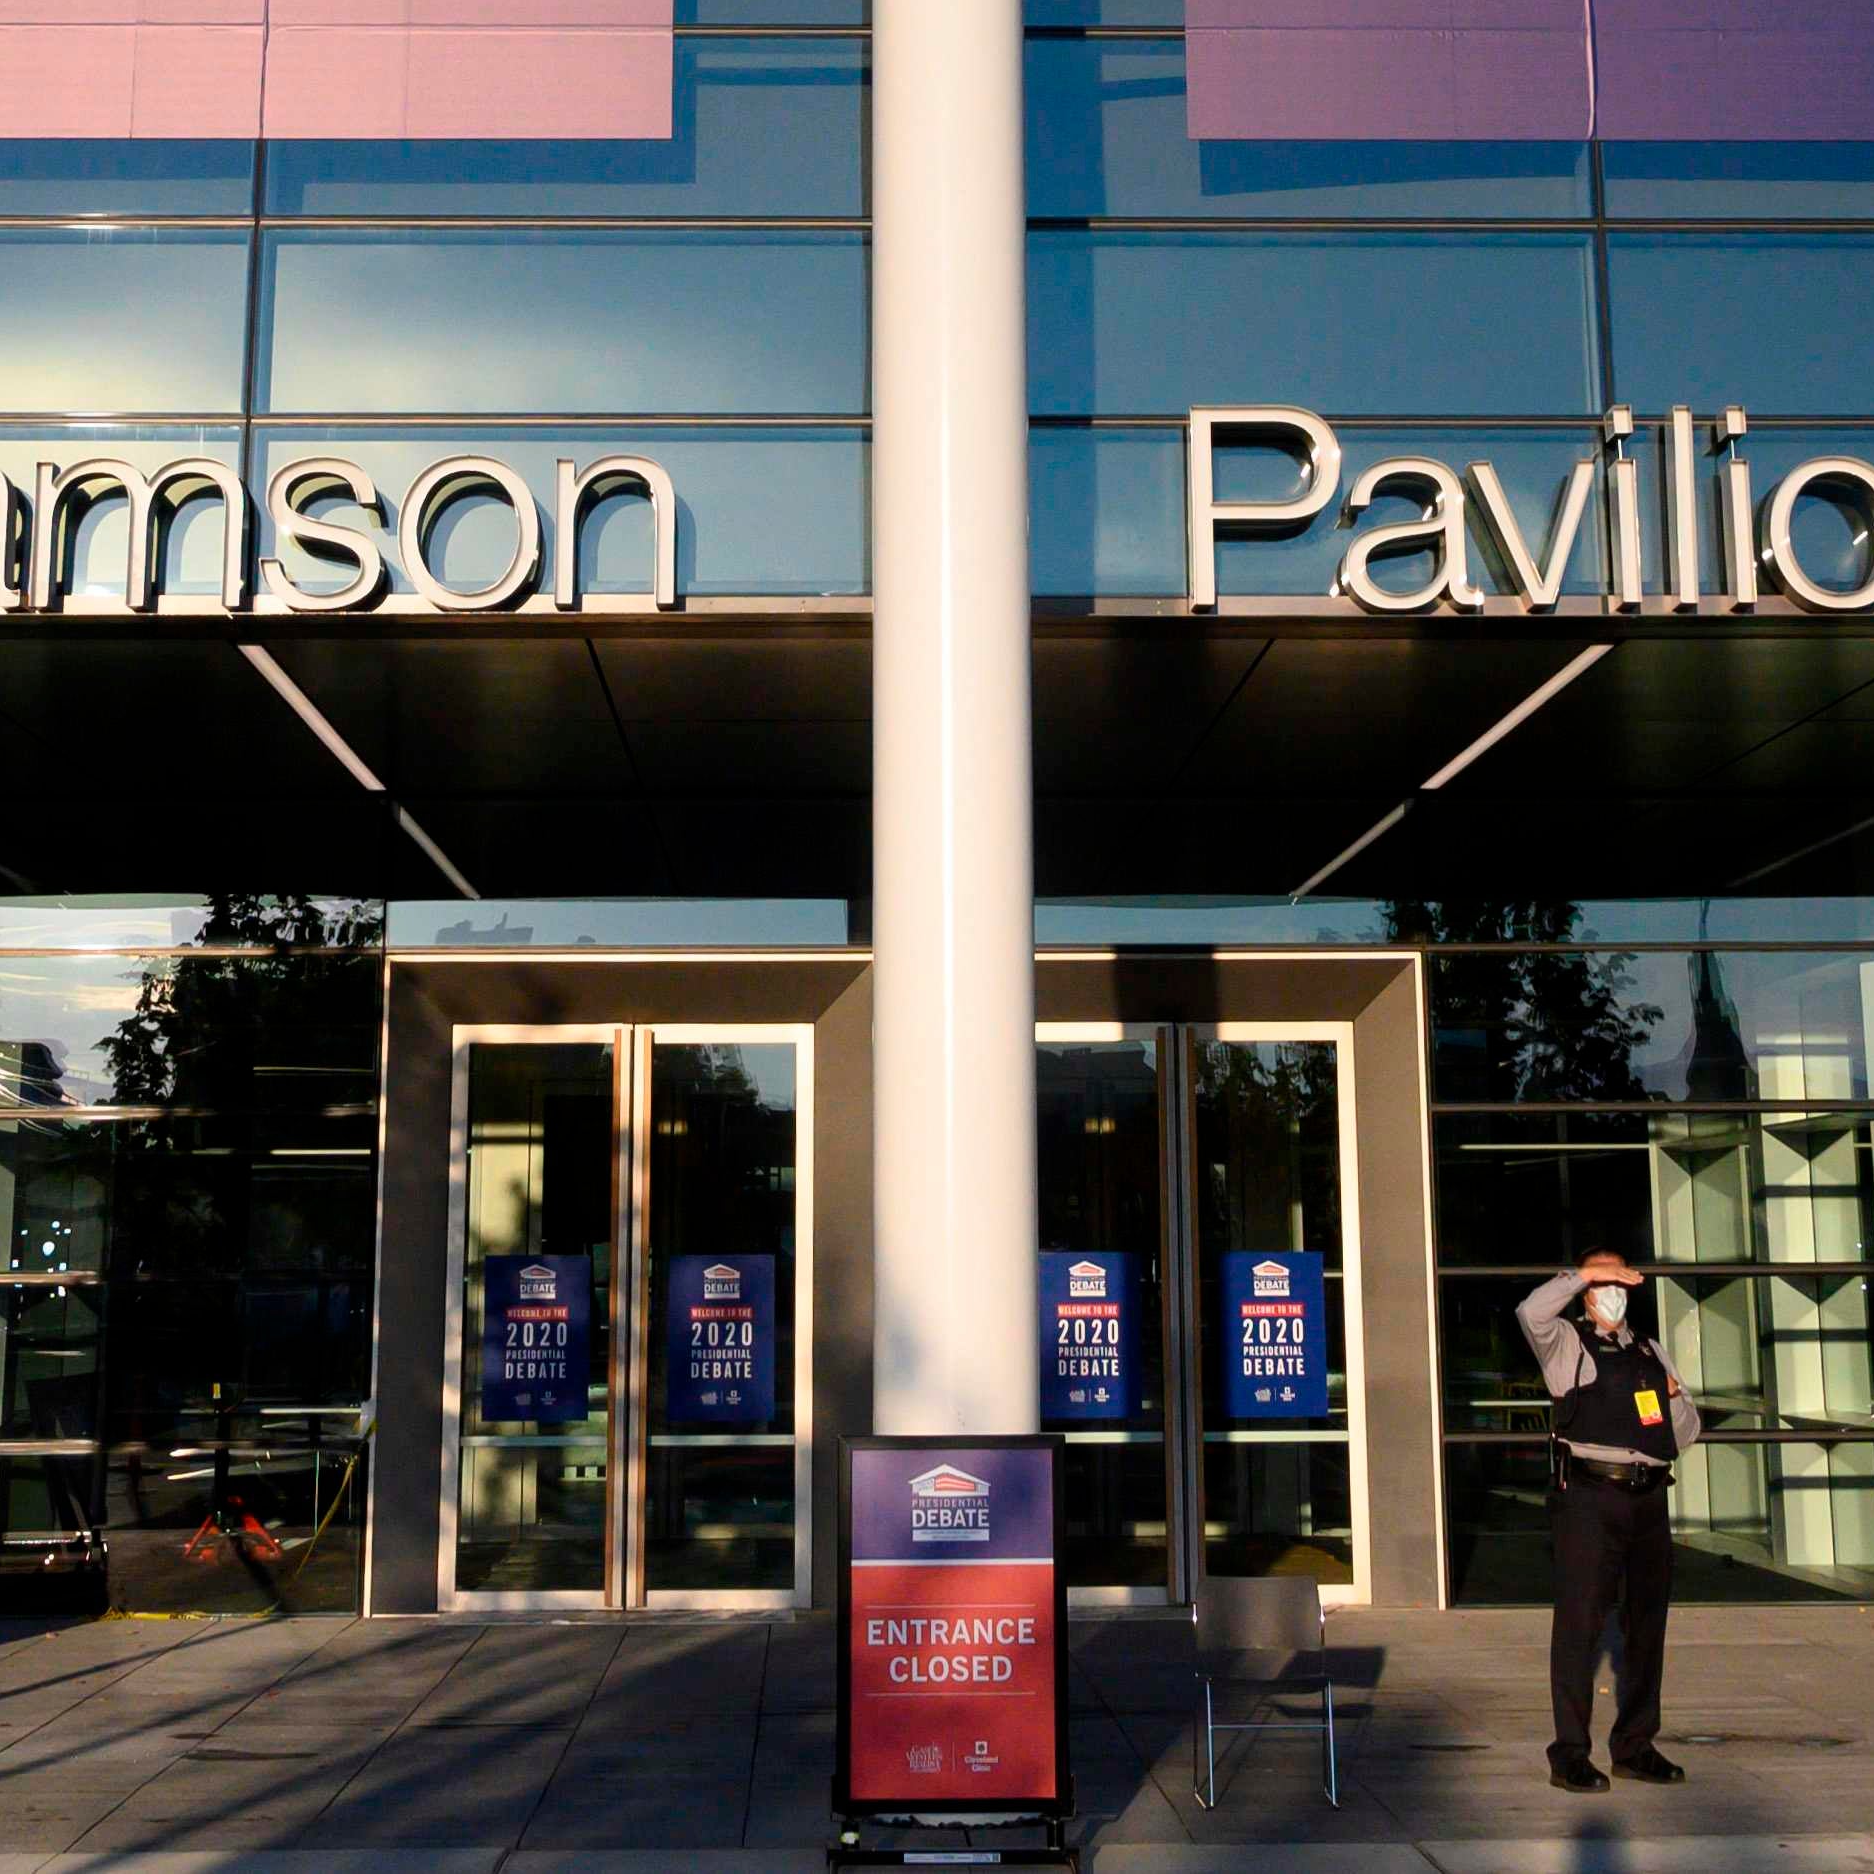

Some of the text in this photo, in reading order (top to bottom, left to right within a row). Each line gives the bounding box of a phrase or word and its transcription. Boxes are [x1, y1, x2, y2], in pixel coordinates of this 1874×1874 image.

[507, 1309, 540, 1318] WELCOME
[691, 1309, 725, 1318] WELCOME
[1058, 1305, 1091, 1315] WELCOME
[1242, 1305, 1275, 1315] WELCOME
[506, 1322, 567, 1346] 2020
[691, 1322, 752, 1346] 2020
[1058, 1319, 1119, 1344] 2020
[1243, 1318, 1304, 1344] 2020
[506, 1349, 566, 1359] PRESIDENTIAL
[691, 1349, 751, 1359] PRESIDENTIAL
[1058, 1346, 1118, 1357] PRESIDENTIAL
[1243, 1346, 1303, 1356] PRESIDENTIAL
[505, 1362, 566, 1379] DEBATE
[691, 1362, 752, 1378] DEBATE
[1058, 1360, 1119, 1376] DEBATE
[1243, 1358, 1305, 1376] DEBATE
[912, 1499, 989, 1508] PRESIDENTIAL
[912, 1509, 990, 1528] DEBATE
[867, 1618, 1036, 1646] ENTRANCE
[889, 1656, 1013, 1682] CLOSED
